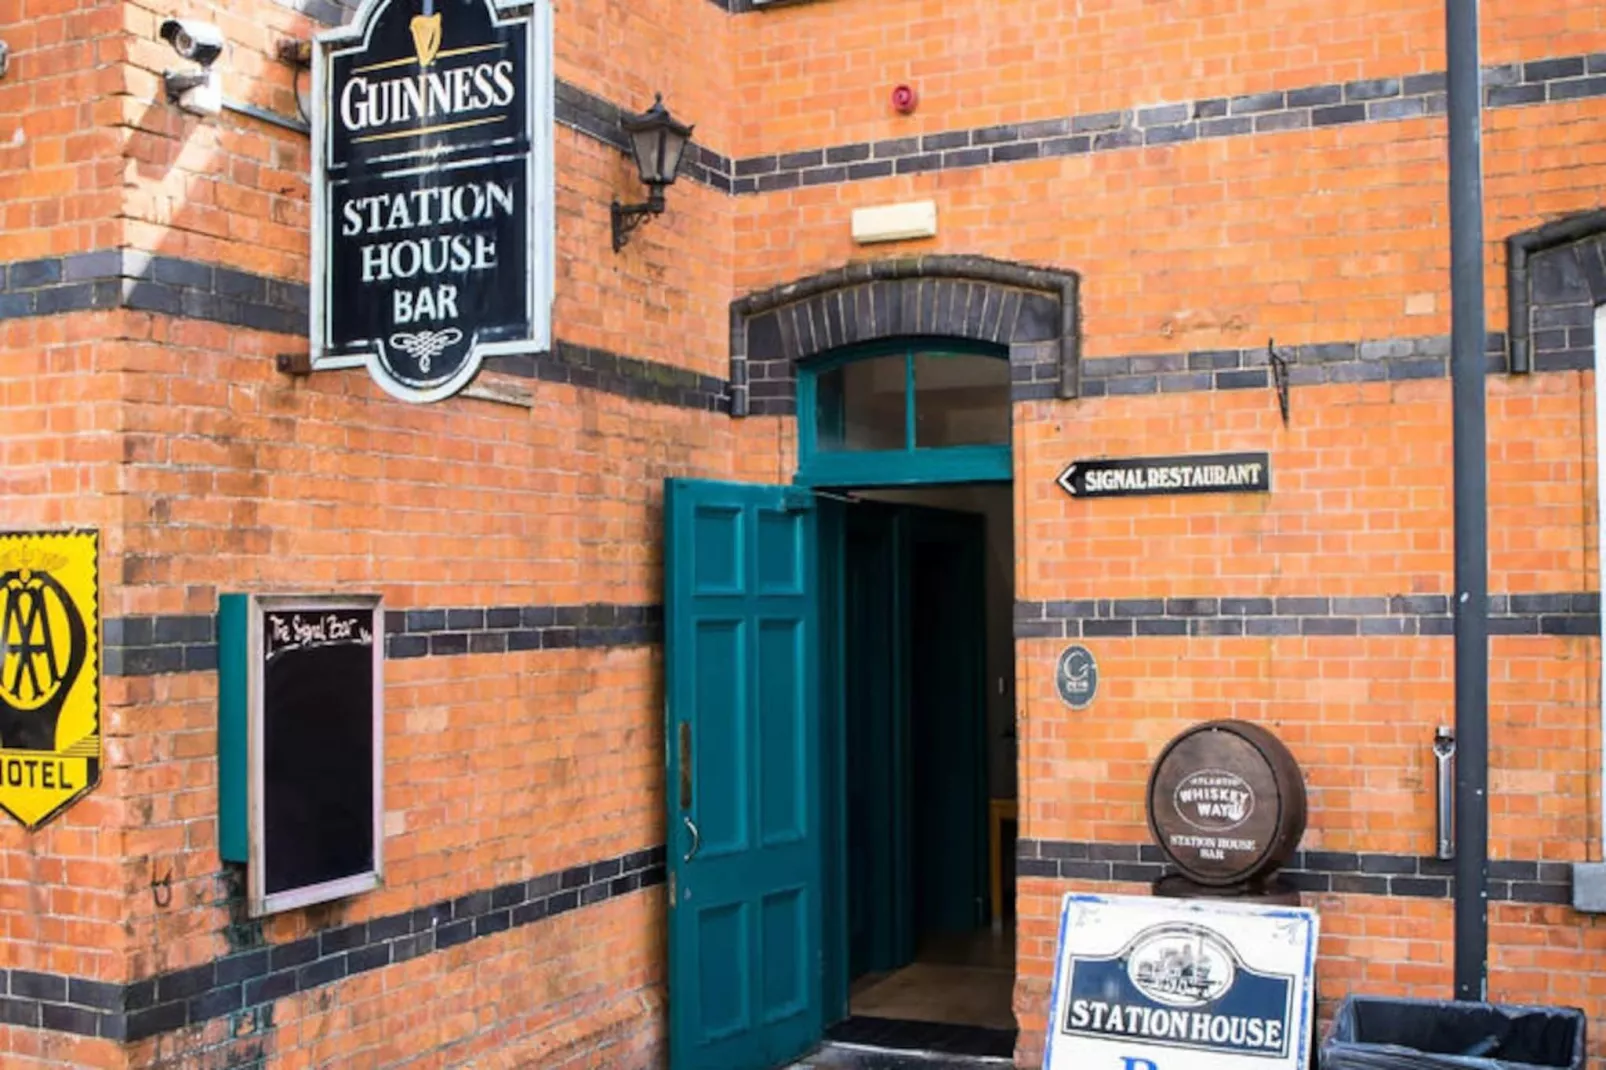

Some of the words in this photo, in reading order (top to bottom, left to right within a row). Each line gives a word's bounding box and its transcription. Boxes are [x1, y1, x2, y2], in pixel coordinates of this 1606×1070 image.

[340, 61, 515, 132] GUINNESS
[342, 181, 514, 237] STATION
[360, 235, 499, 283] HOUSE
[392, 284, 460, 325] BAR
[1084, 467, 1147, 492] SIGNAL
[1147, 463, 1262, 488] RESTAURANT
[0, 759, 73, 790] OTEL
[1179, 787, 1249, 803] WHISKEY
[1197, 803, 1234, 818] WAY
[1170, 835, 1216, 849] STATION
[1217, 838, 1257, 852] HOUSE
[1070, 1000, 1188, 1038] STATION
[1191, 1013, 1283, 1048] HOUSE
